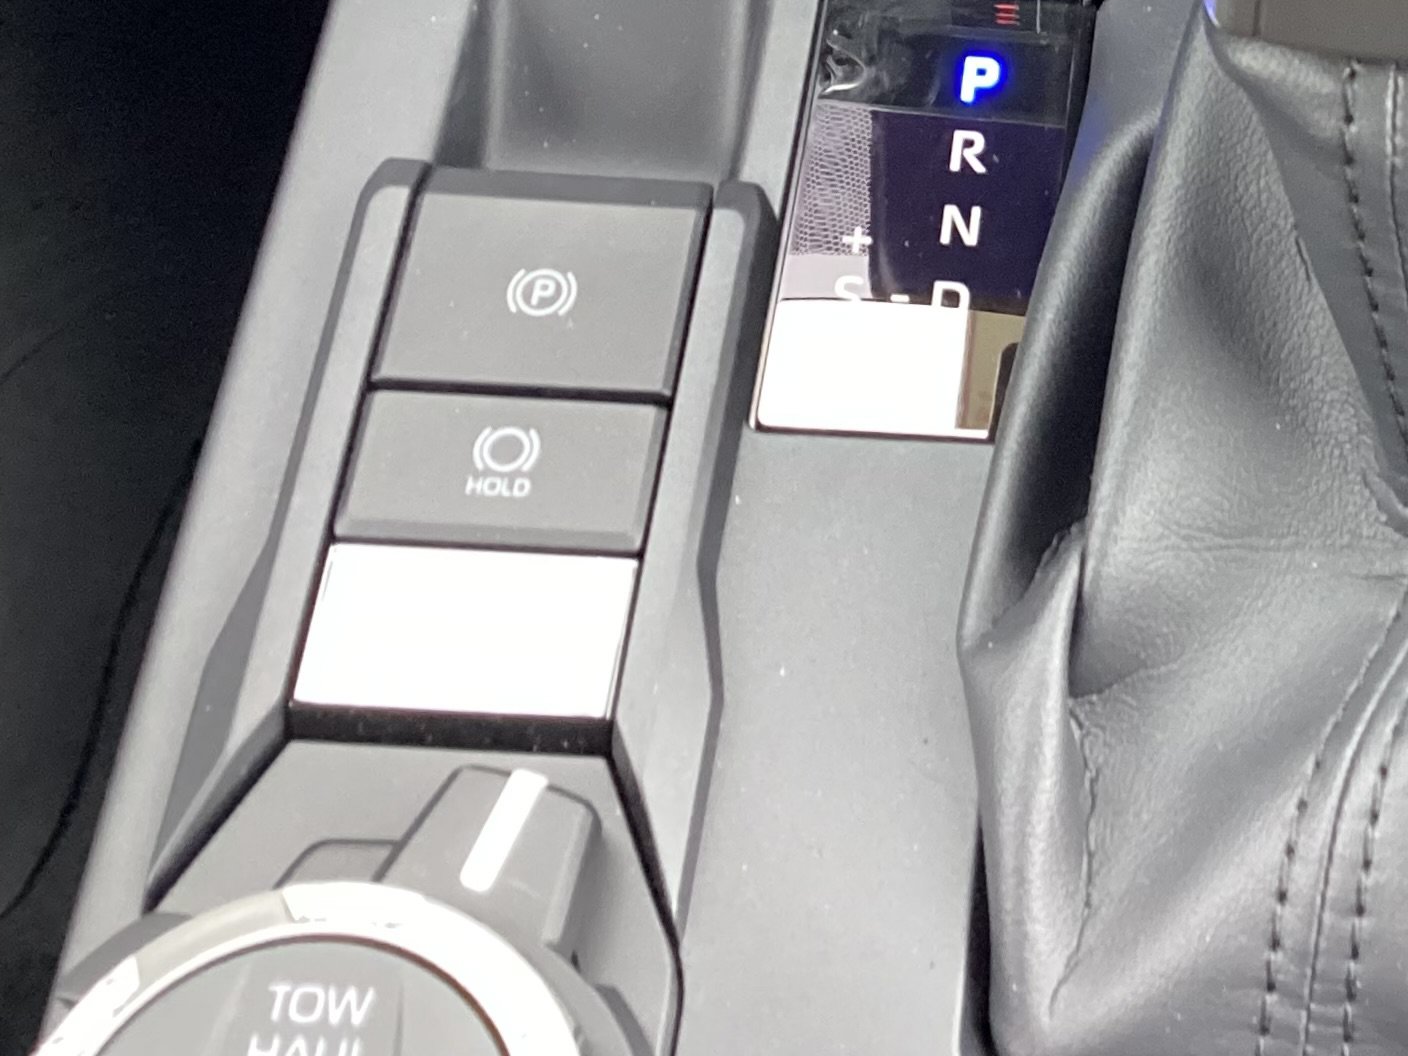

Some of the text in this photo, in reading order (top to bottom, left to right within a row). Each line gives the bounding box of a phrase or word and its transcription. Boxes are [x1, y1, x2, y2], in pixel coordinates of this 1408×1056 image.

[960, 55, 1001, 102] P
[948, 130, 987, 174] R
[939, 204, 982, 246] N
[465, 475, 532, 497] HOLD
[268, 983, 375, 1026] TOW
